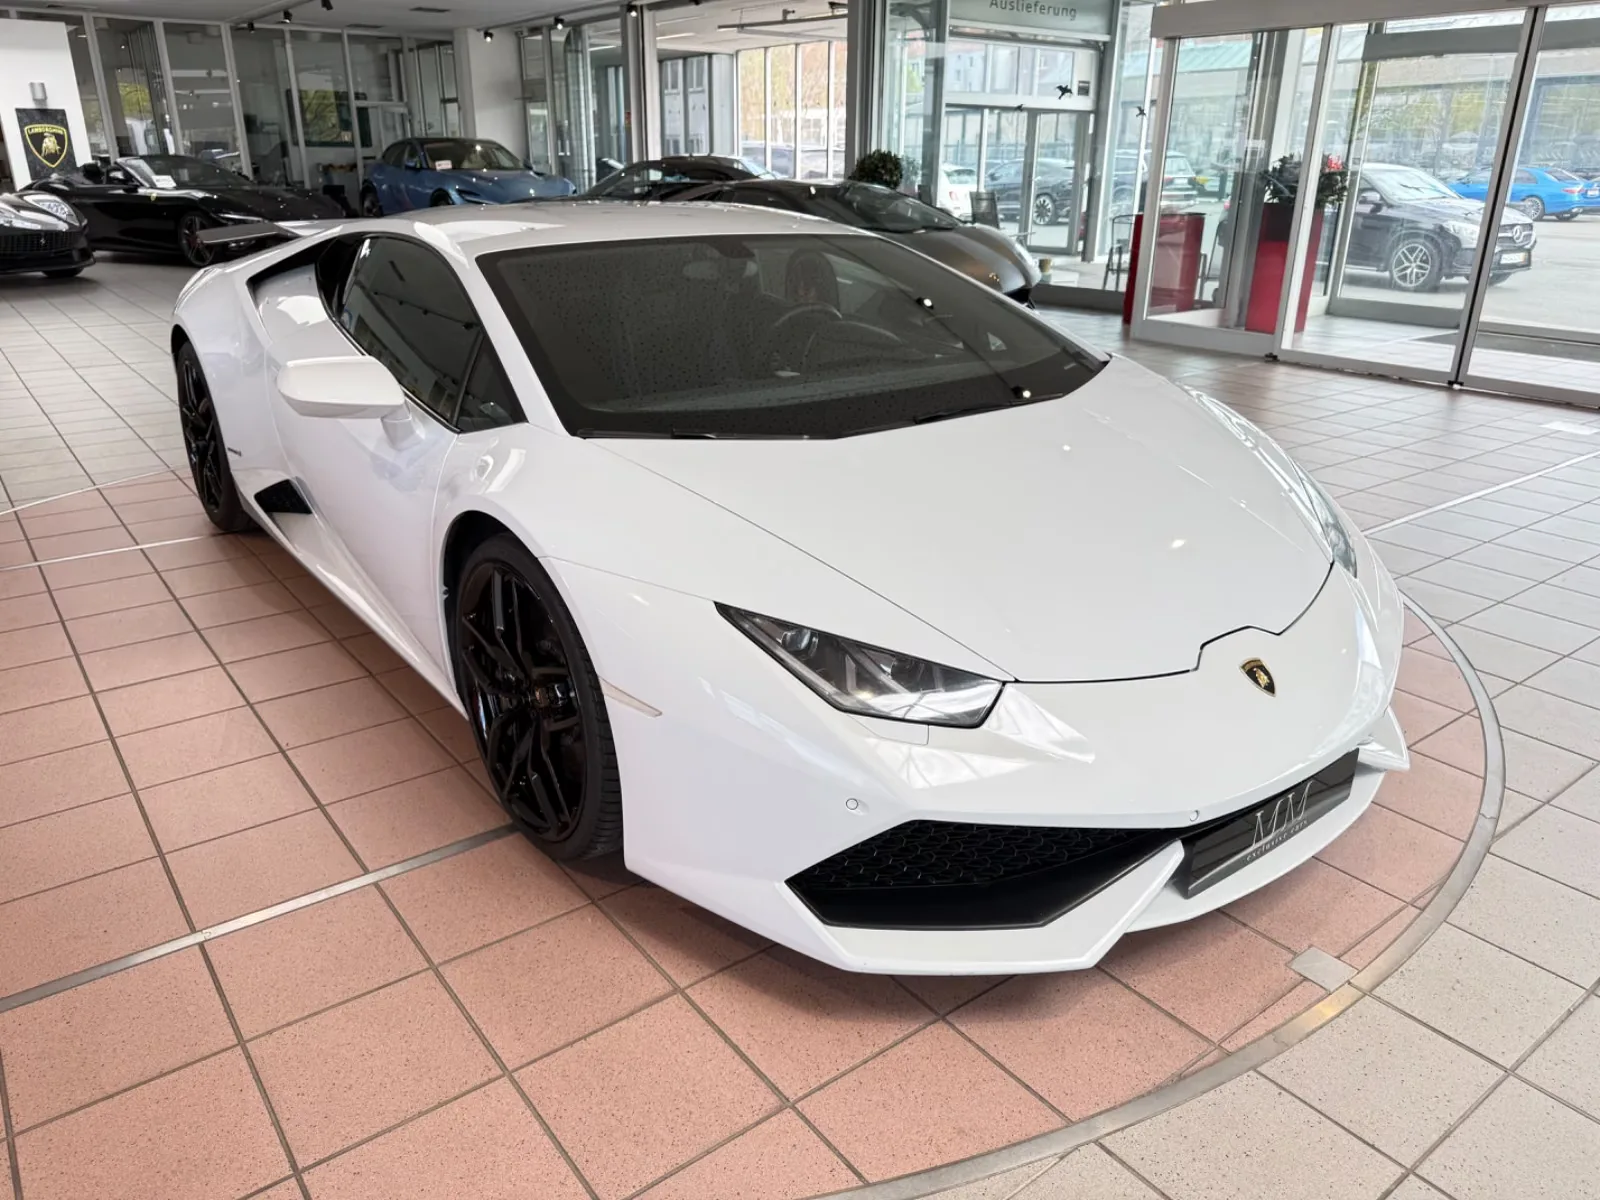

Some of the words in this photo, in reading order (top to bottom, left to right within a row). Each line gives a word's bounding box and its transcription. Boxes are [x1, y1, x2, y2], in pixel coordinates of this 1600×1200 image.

[989, 0, 1077, 21] Auslieferung
[1246, 832, 1288, 862] exclusive
[1290, 819, 1308, 834] cars
